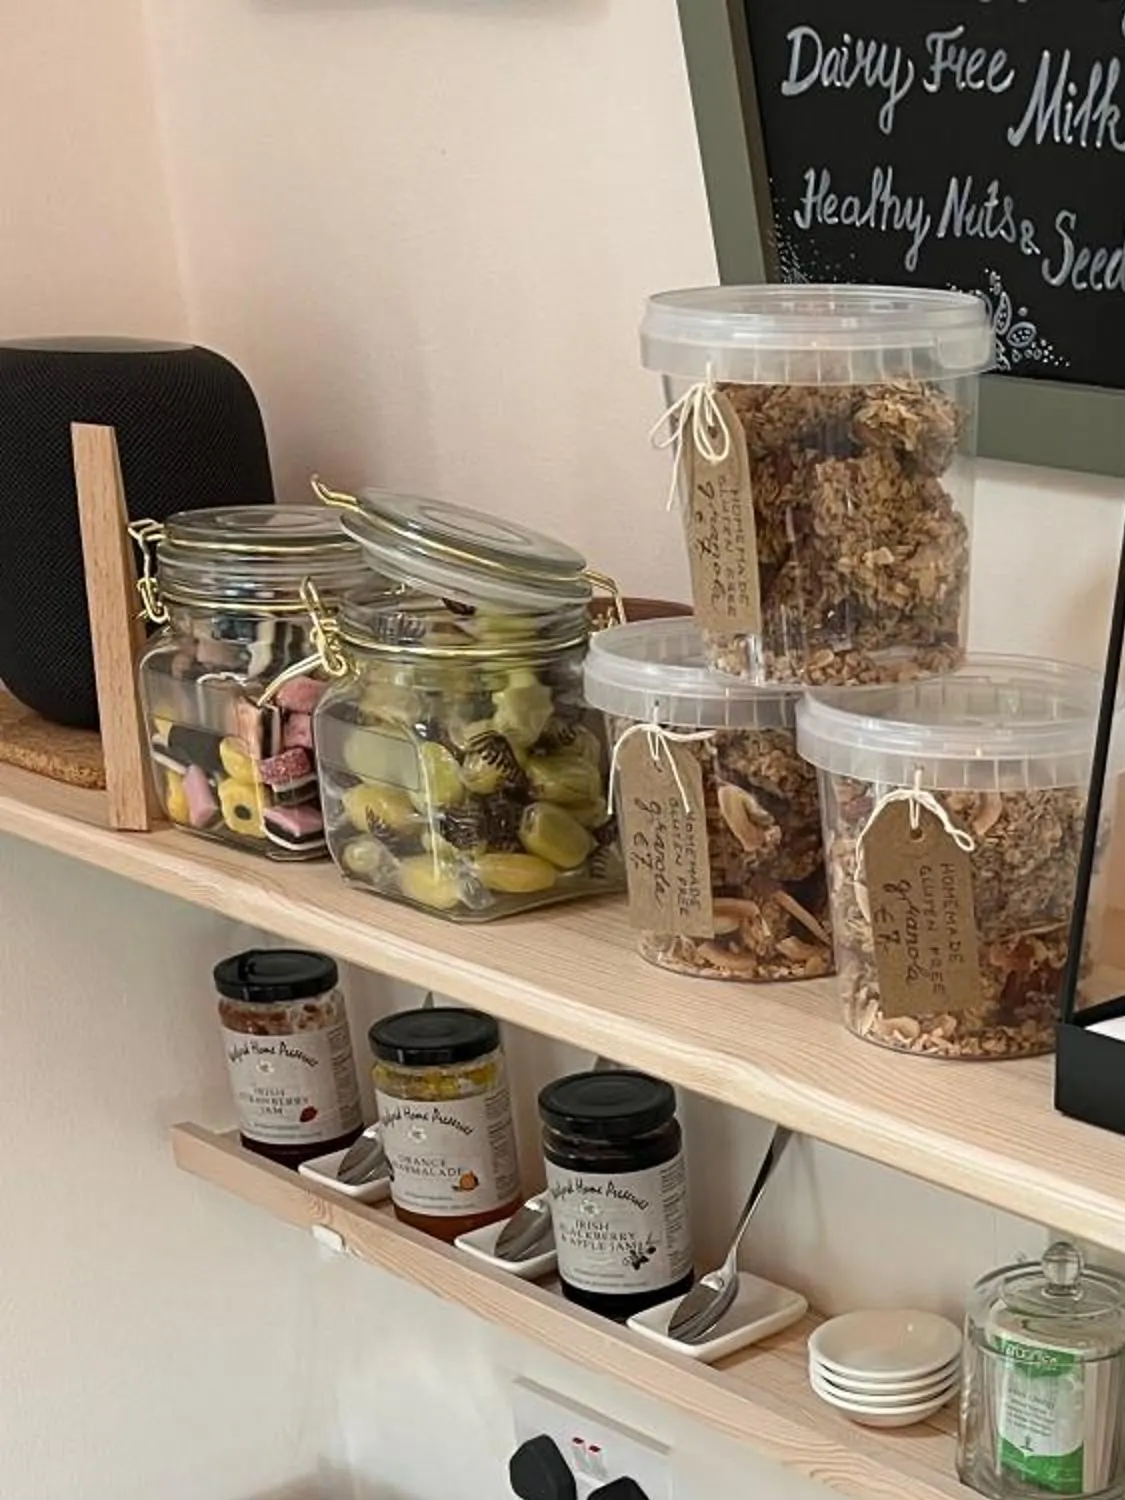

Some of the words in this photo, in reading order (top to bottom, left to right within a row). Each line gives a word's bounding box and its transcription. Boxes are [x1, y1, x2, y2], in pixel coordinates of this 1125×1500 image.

[781, 26, 915, 134] Dairy
[923, 25, 1015, 93] Free
[794, 165, 931, 273] Healthy
[936, 175, 1018, 244] Nuts
